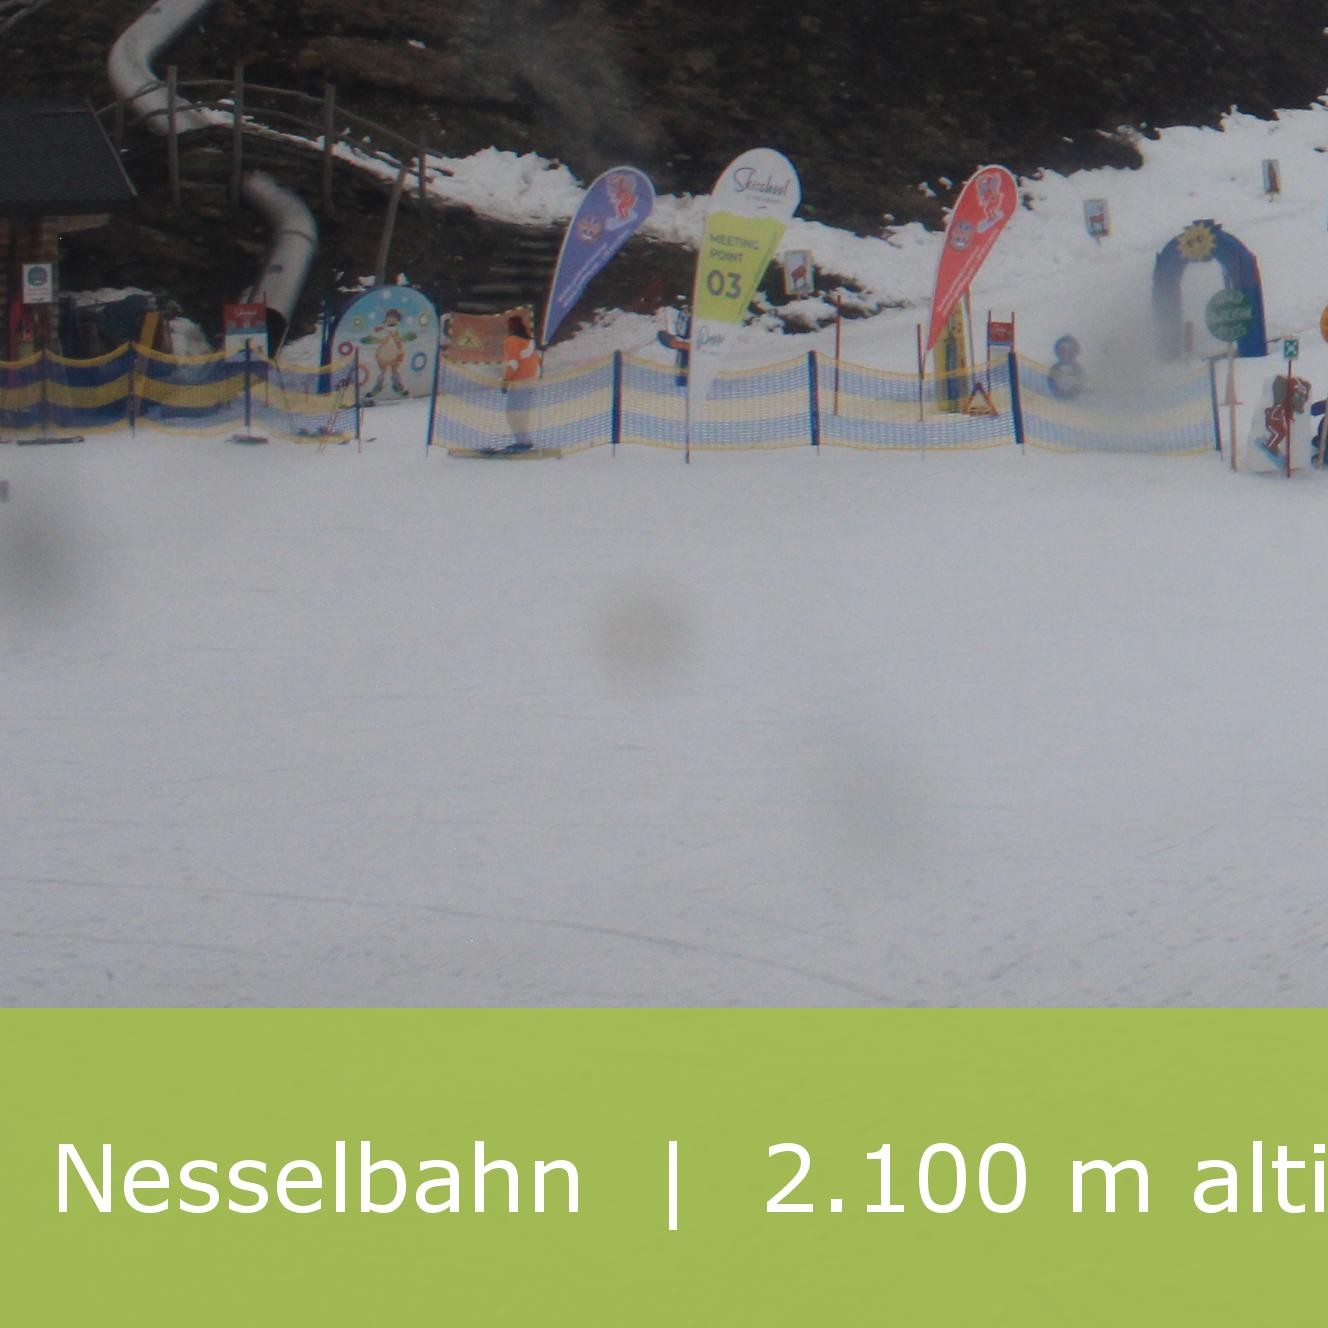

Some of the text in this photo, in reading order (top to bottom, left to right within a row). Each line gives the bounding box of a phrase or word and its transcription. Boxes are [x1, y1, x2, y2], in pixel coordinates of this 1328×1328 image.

[709, 232, 760, 251] MEETING
[709, 247, 744, 263] POINT
[706, 269, 743, 300] 03
